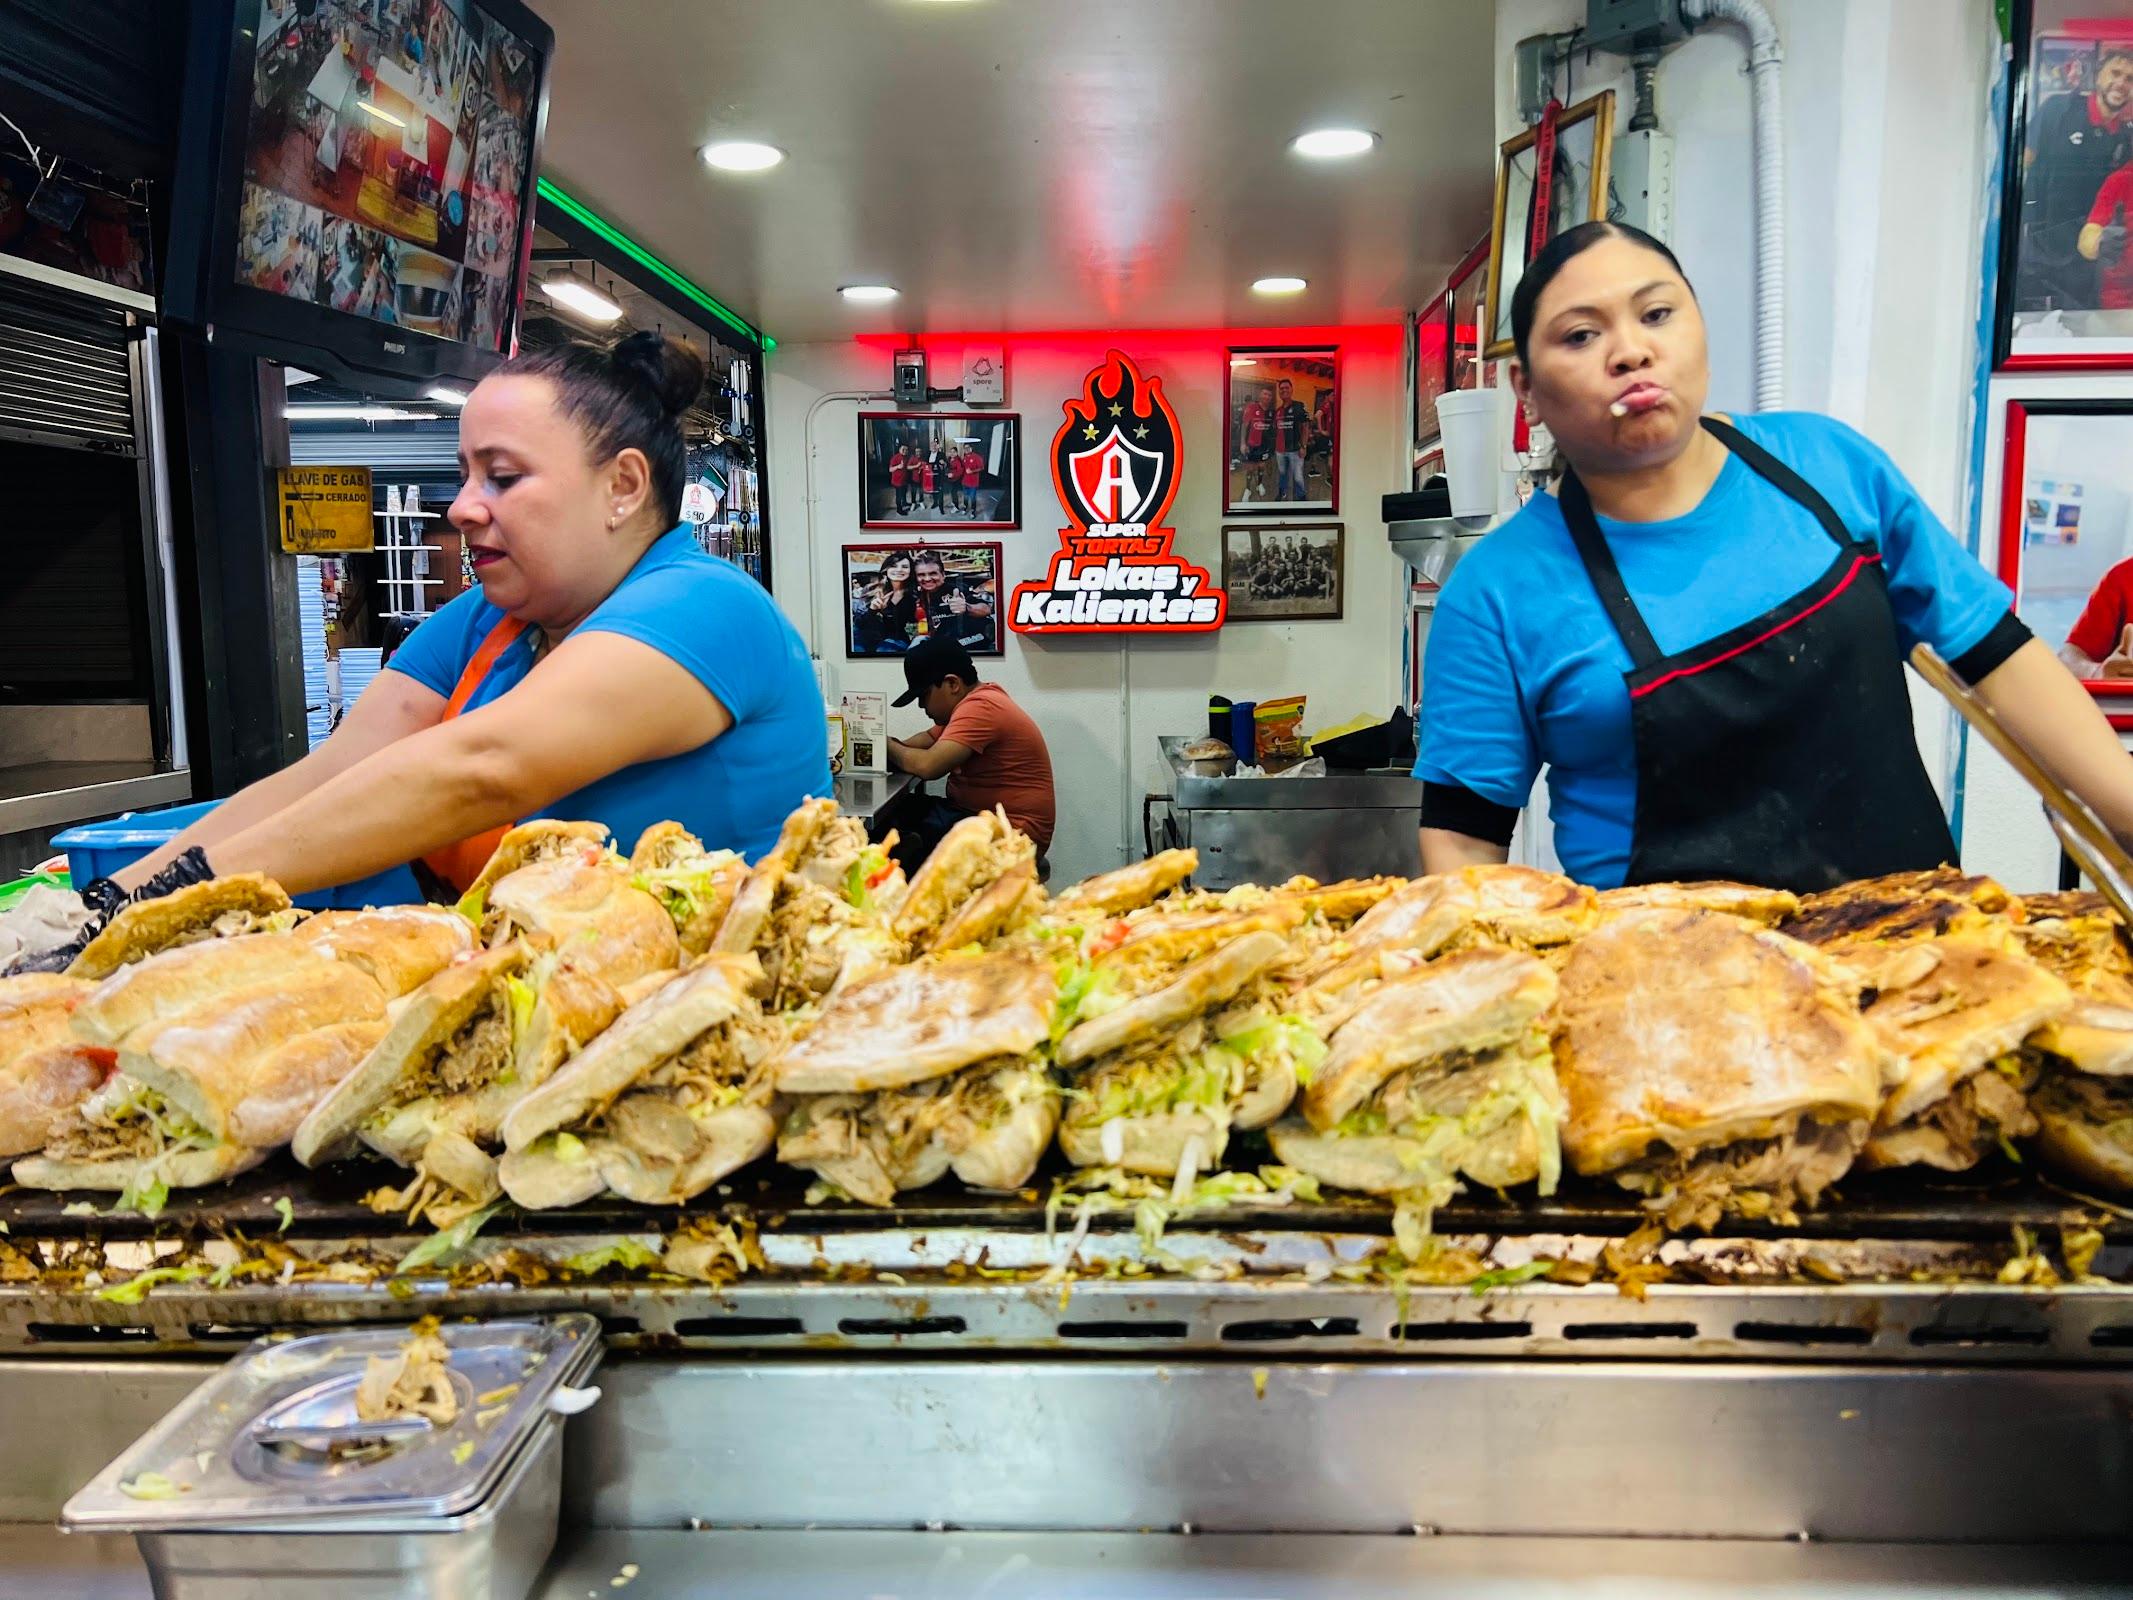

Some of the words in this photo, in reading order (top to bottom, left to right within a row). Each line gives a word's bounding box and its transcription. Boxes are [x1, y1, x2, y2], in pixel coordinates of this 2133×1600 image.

[285, 473, 319, 485] LLAVE
[323, 474, 337, 485] DE
[341, 474, 364, 486] GAS
[326, 493, 366, 502] CERRADO
[1086, 523, 1146, 537] SUPER
[1071, 538, 1161, 554] TORTAS
[1054, 558, 1178, 591] Lokas
[1180, 576, 1199, 596] y
[1016, 591, 1218, 624] Kalientes
